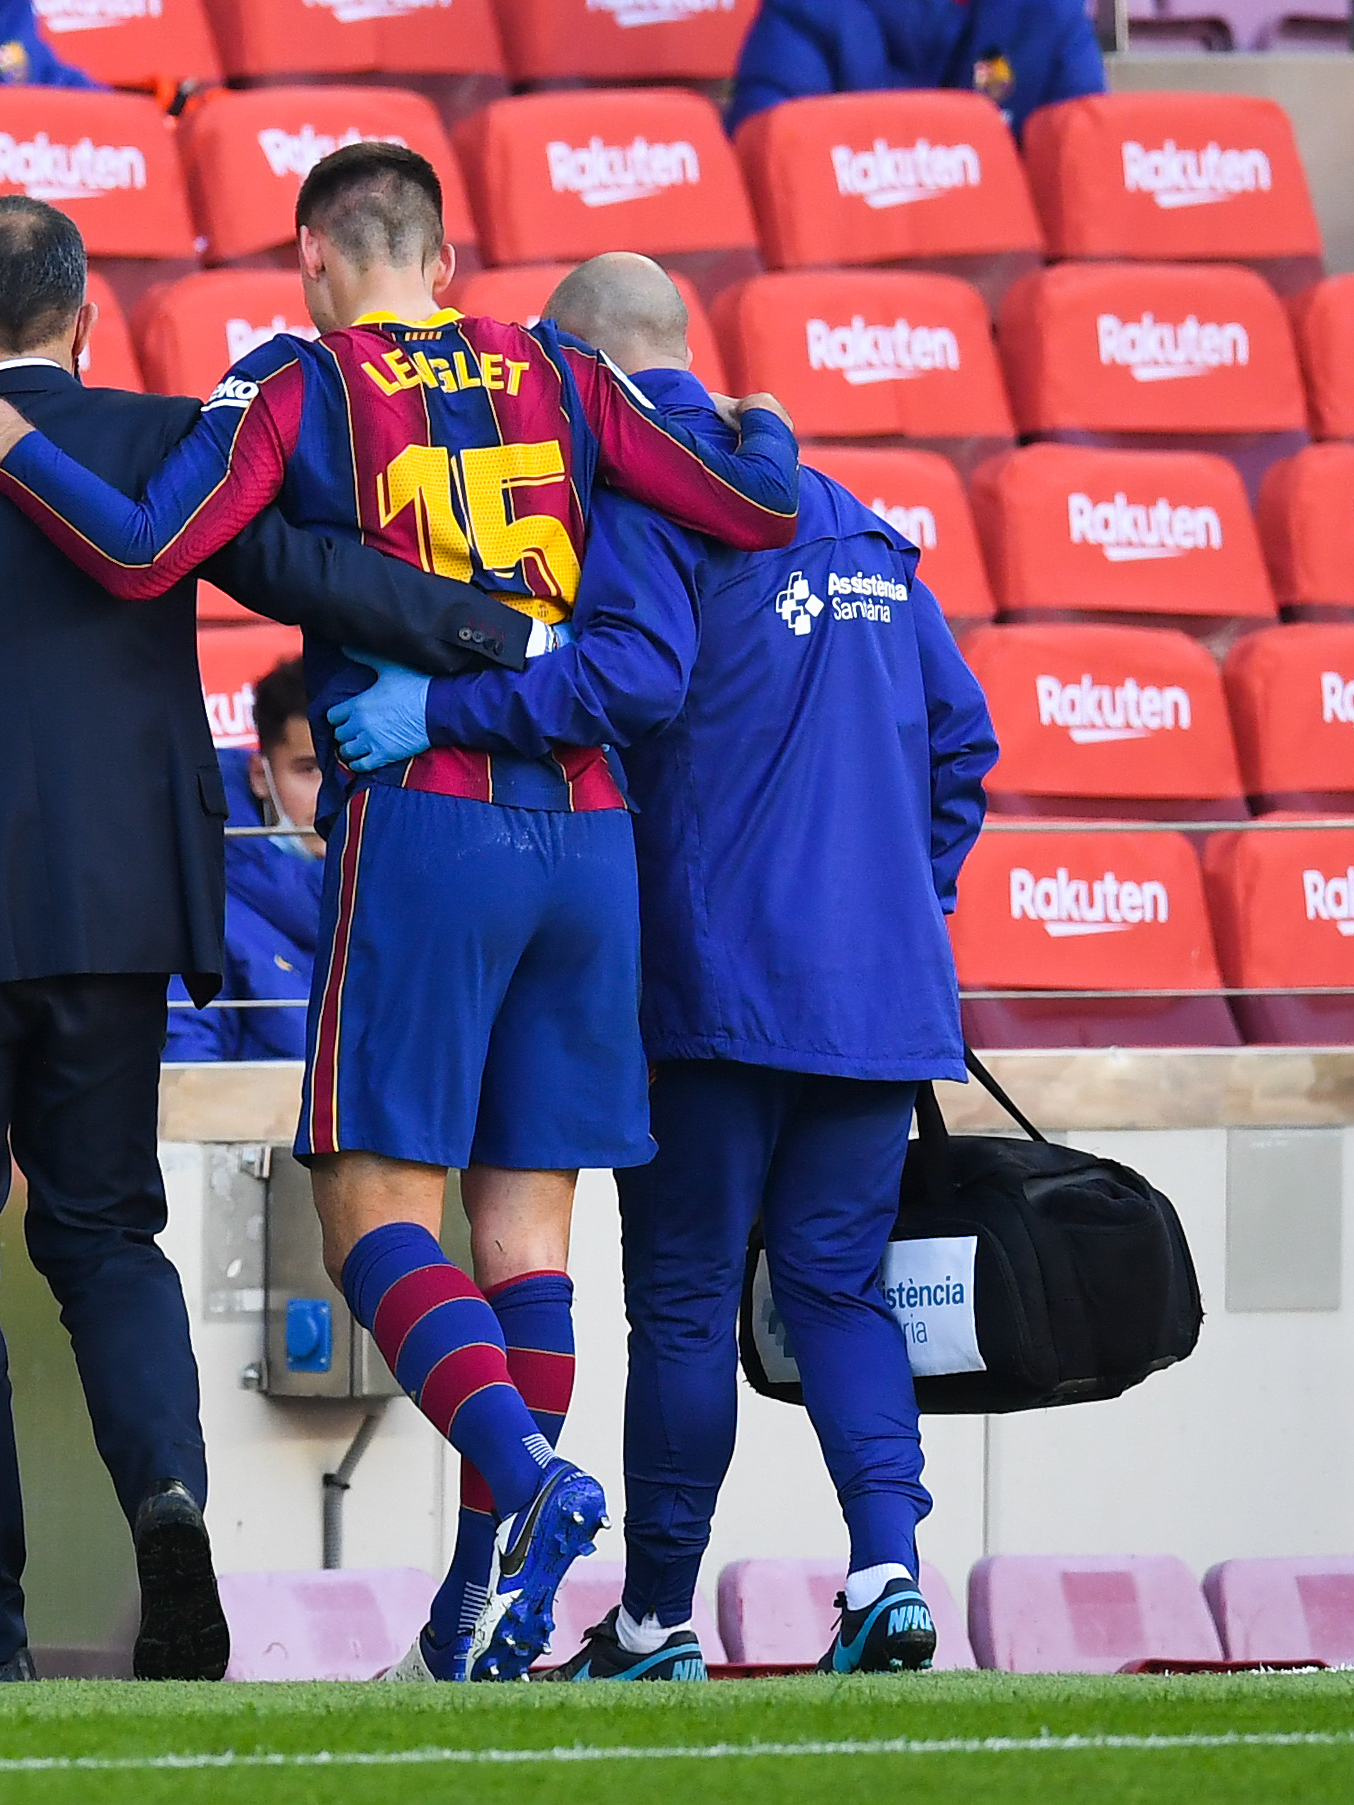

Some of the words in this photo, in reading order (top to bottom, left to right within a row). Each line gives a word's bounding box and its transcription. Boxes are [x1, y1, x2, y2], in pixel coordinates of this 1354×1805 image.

[546, 136, 699, 191] Rakuten
[832, 138, 980, 194] Rakuten
[1121, 138, 1272, 192] Rakuten
[806, 315, 959, 370] Rakuten
[1096, 312, 1249, 364] Rakuten
[207, 376, 259, 402] eko
[360, 348, 530, 397] LENGLET
[377, 440, 583, 625] 15
[1067, 492, 1222, 549] Rakuten
[1036, 673, 1191, 729] Rakuten
[1010, 867, 1169, 922] Rakuten
[881, 1275, 964, 1309] istència
